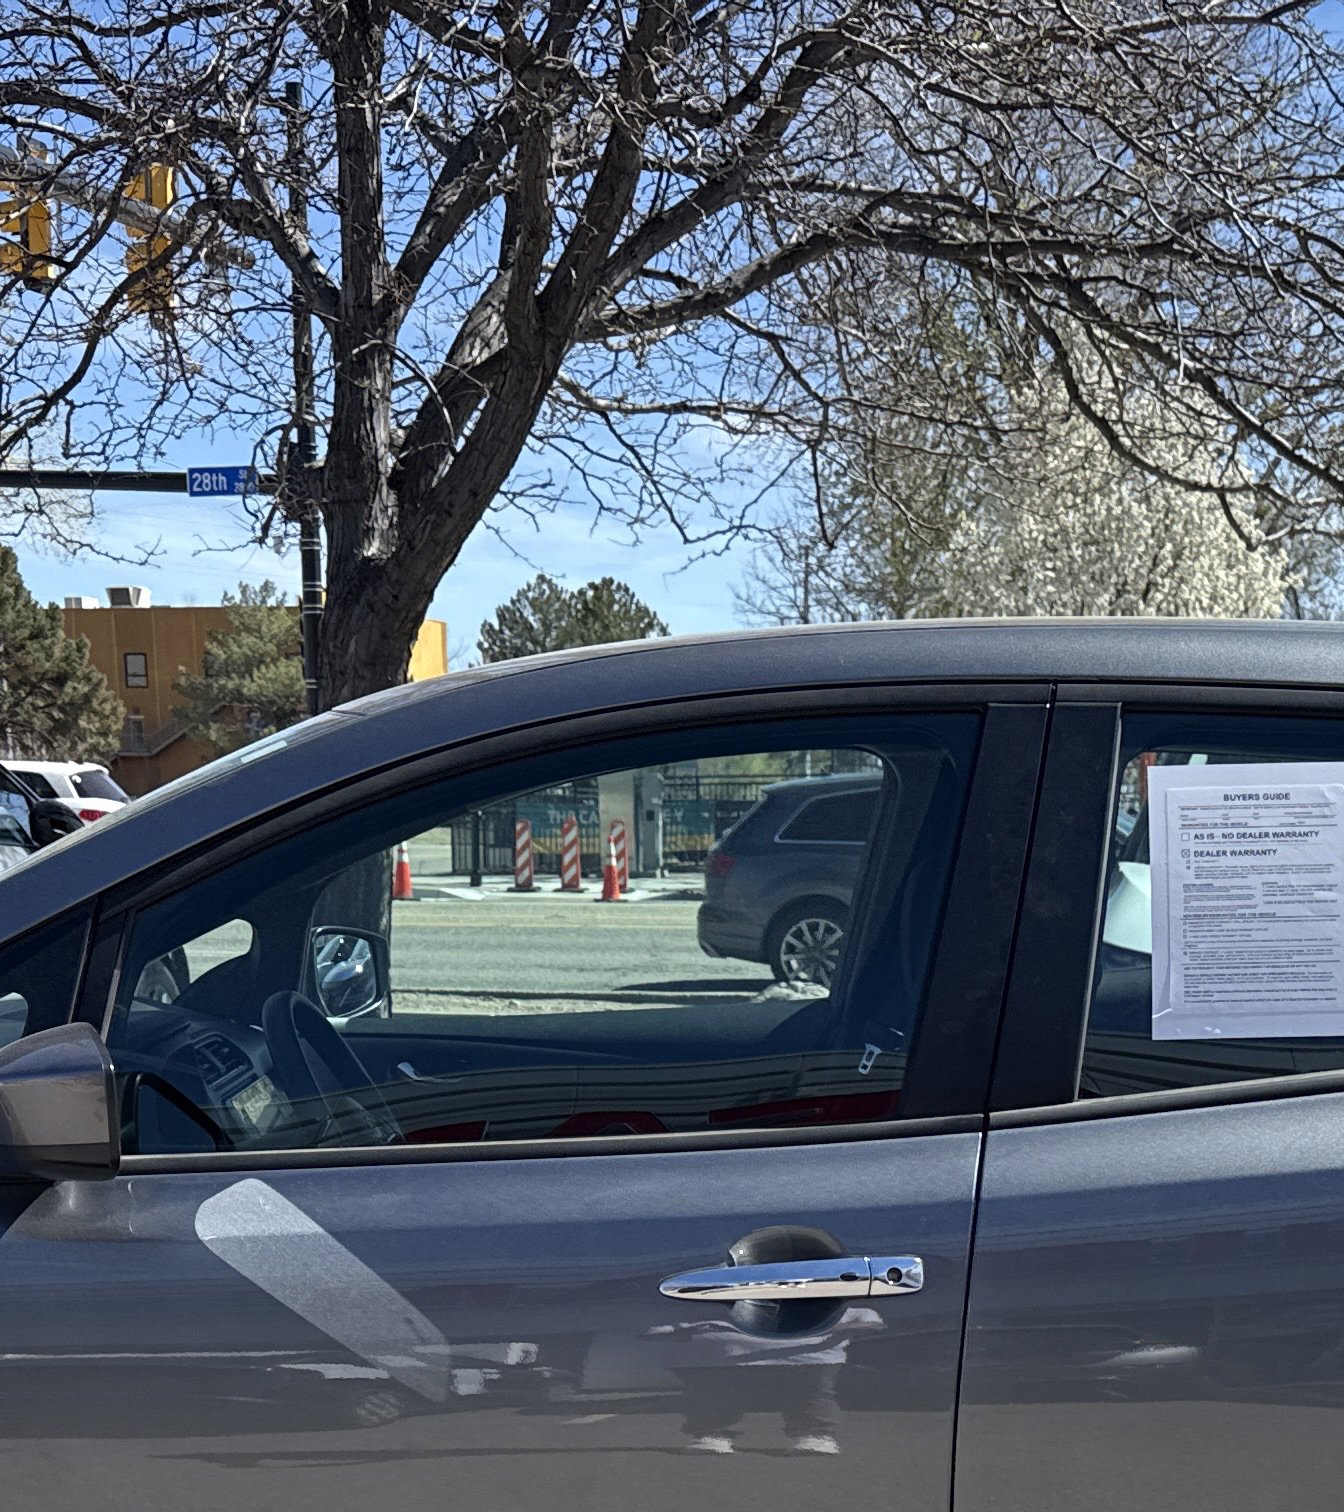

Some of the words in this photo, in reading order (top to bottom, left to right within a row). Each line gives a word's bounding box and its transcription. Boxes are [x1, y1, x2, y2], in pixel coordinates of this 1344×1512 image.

[192, 472, 227, 491] 28th
[1223, 793, 1261, 802] BUYERS
[1262, 792, 1291, 801] GUIDE
[1193, 833, 1205, 841] AS
[1221, 832, 1235, 840] NO
[1236, 831, 1270, 840] DEALER
[1272, 830, 1320, 839] WARRANTY
[1193, 849, 1228, 858] DEALER
[1229, 848, 1278, 857] WARRANTY
